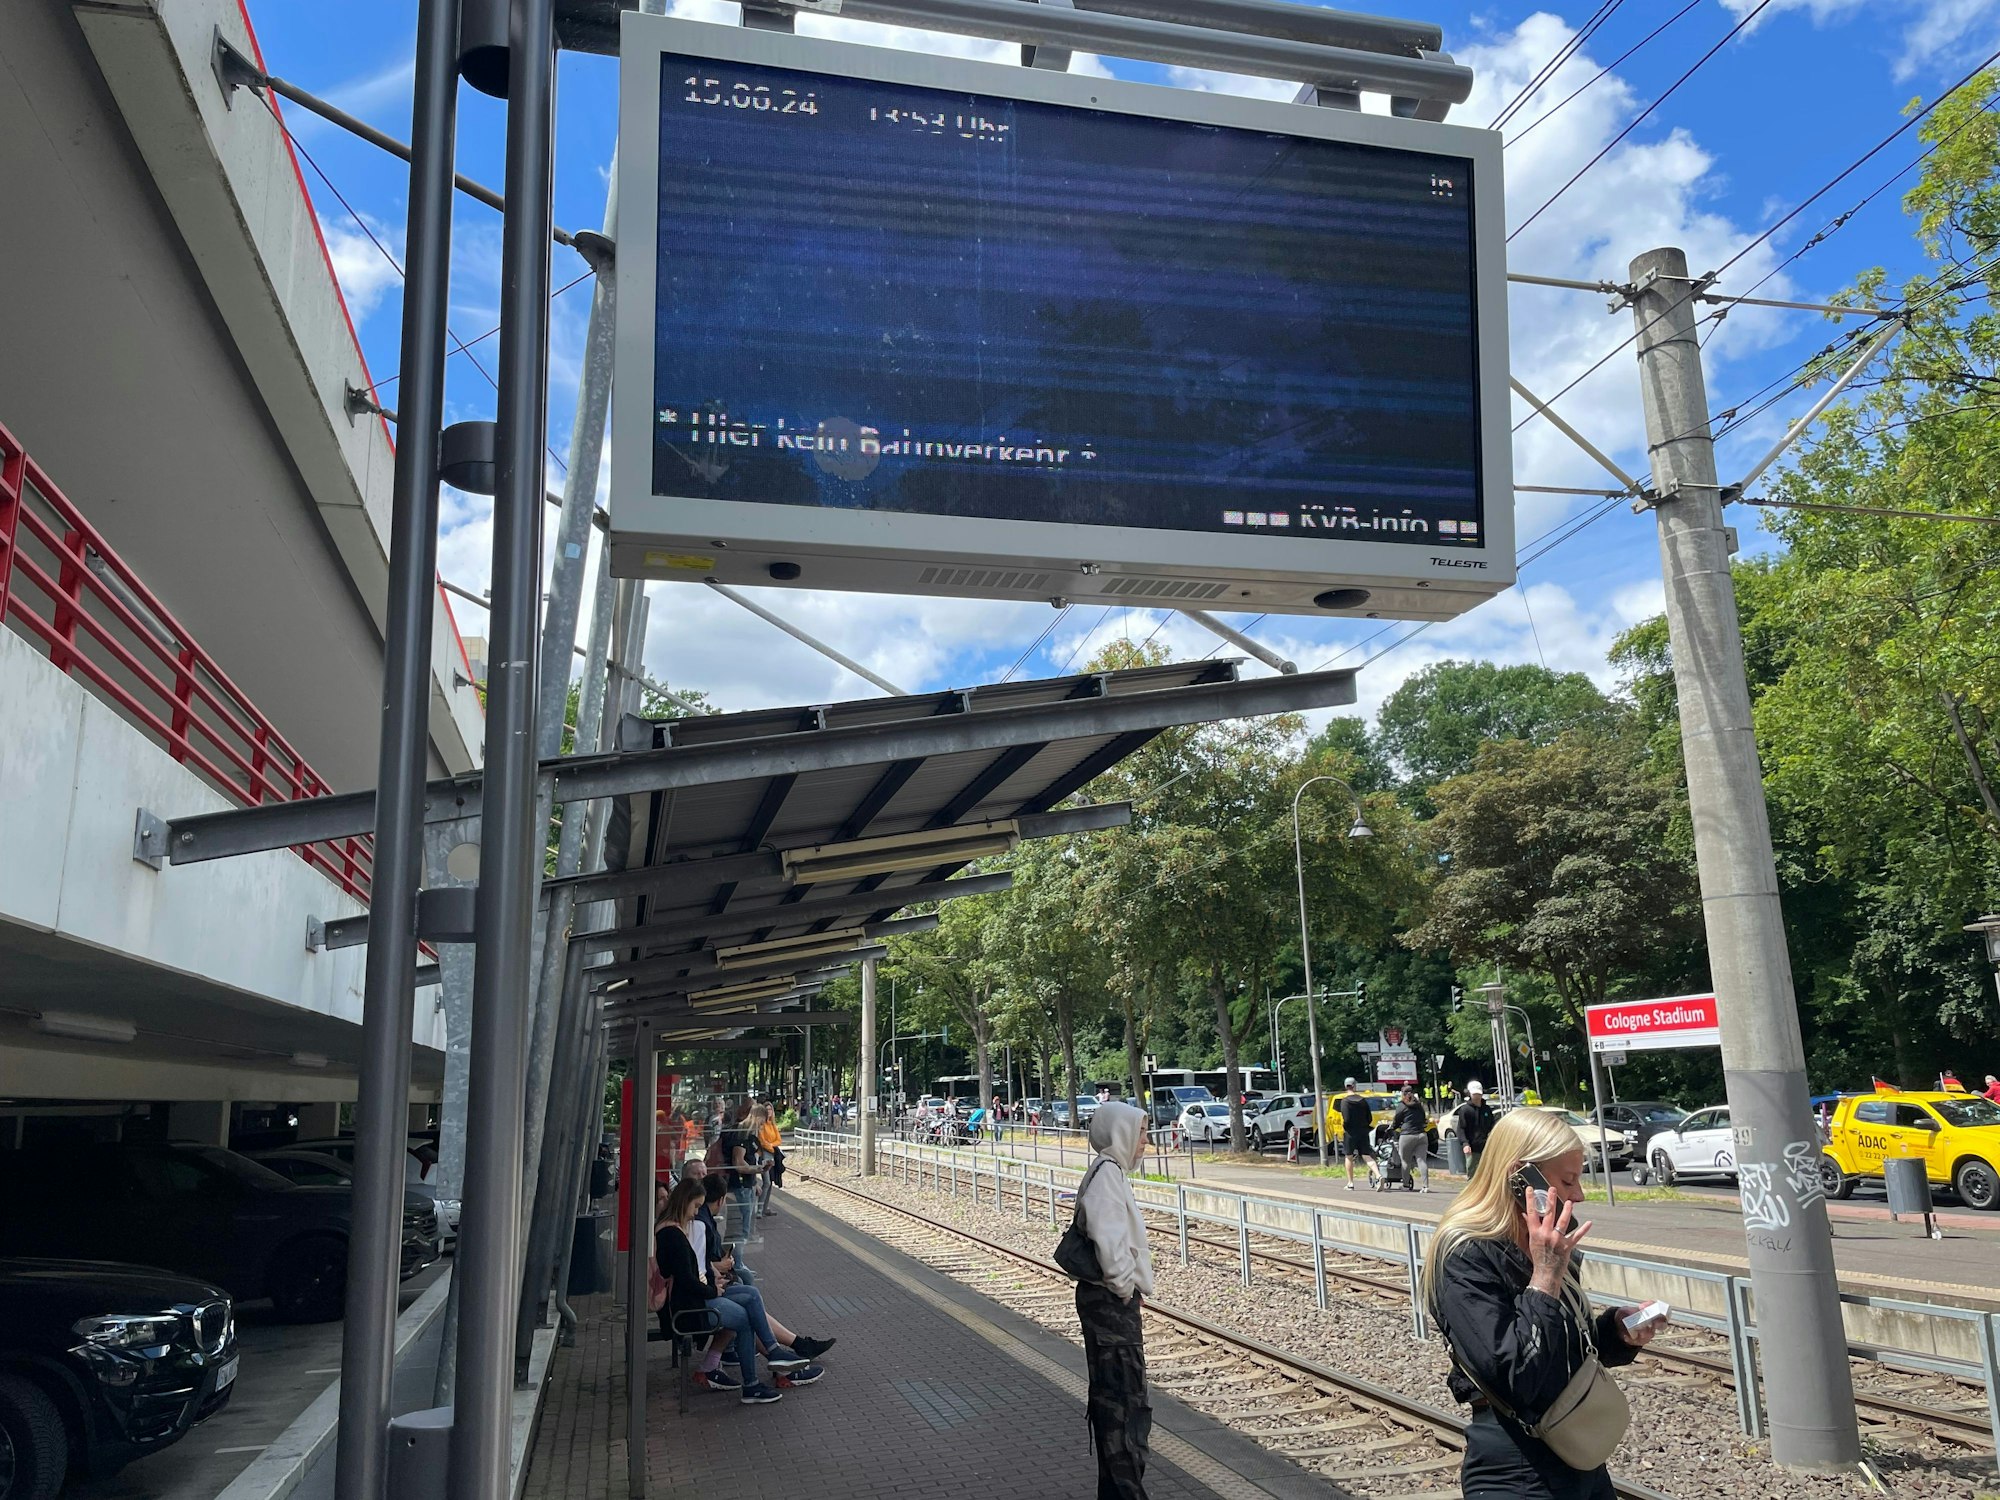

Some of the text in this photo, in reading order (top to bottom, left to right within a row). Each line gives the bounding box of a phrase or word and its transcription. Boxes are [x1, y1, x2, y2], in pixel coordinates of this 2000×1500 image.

[1430, 557, 1488, 569] TELESTE
[1604, 1007, 1705, 1031] Cologne Stadium
[1144, 1055, 1157, 1071] H
[1858, 1134, 1887, 1150] ADAC
